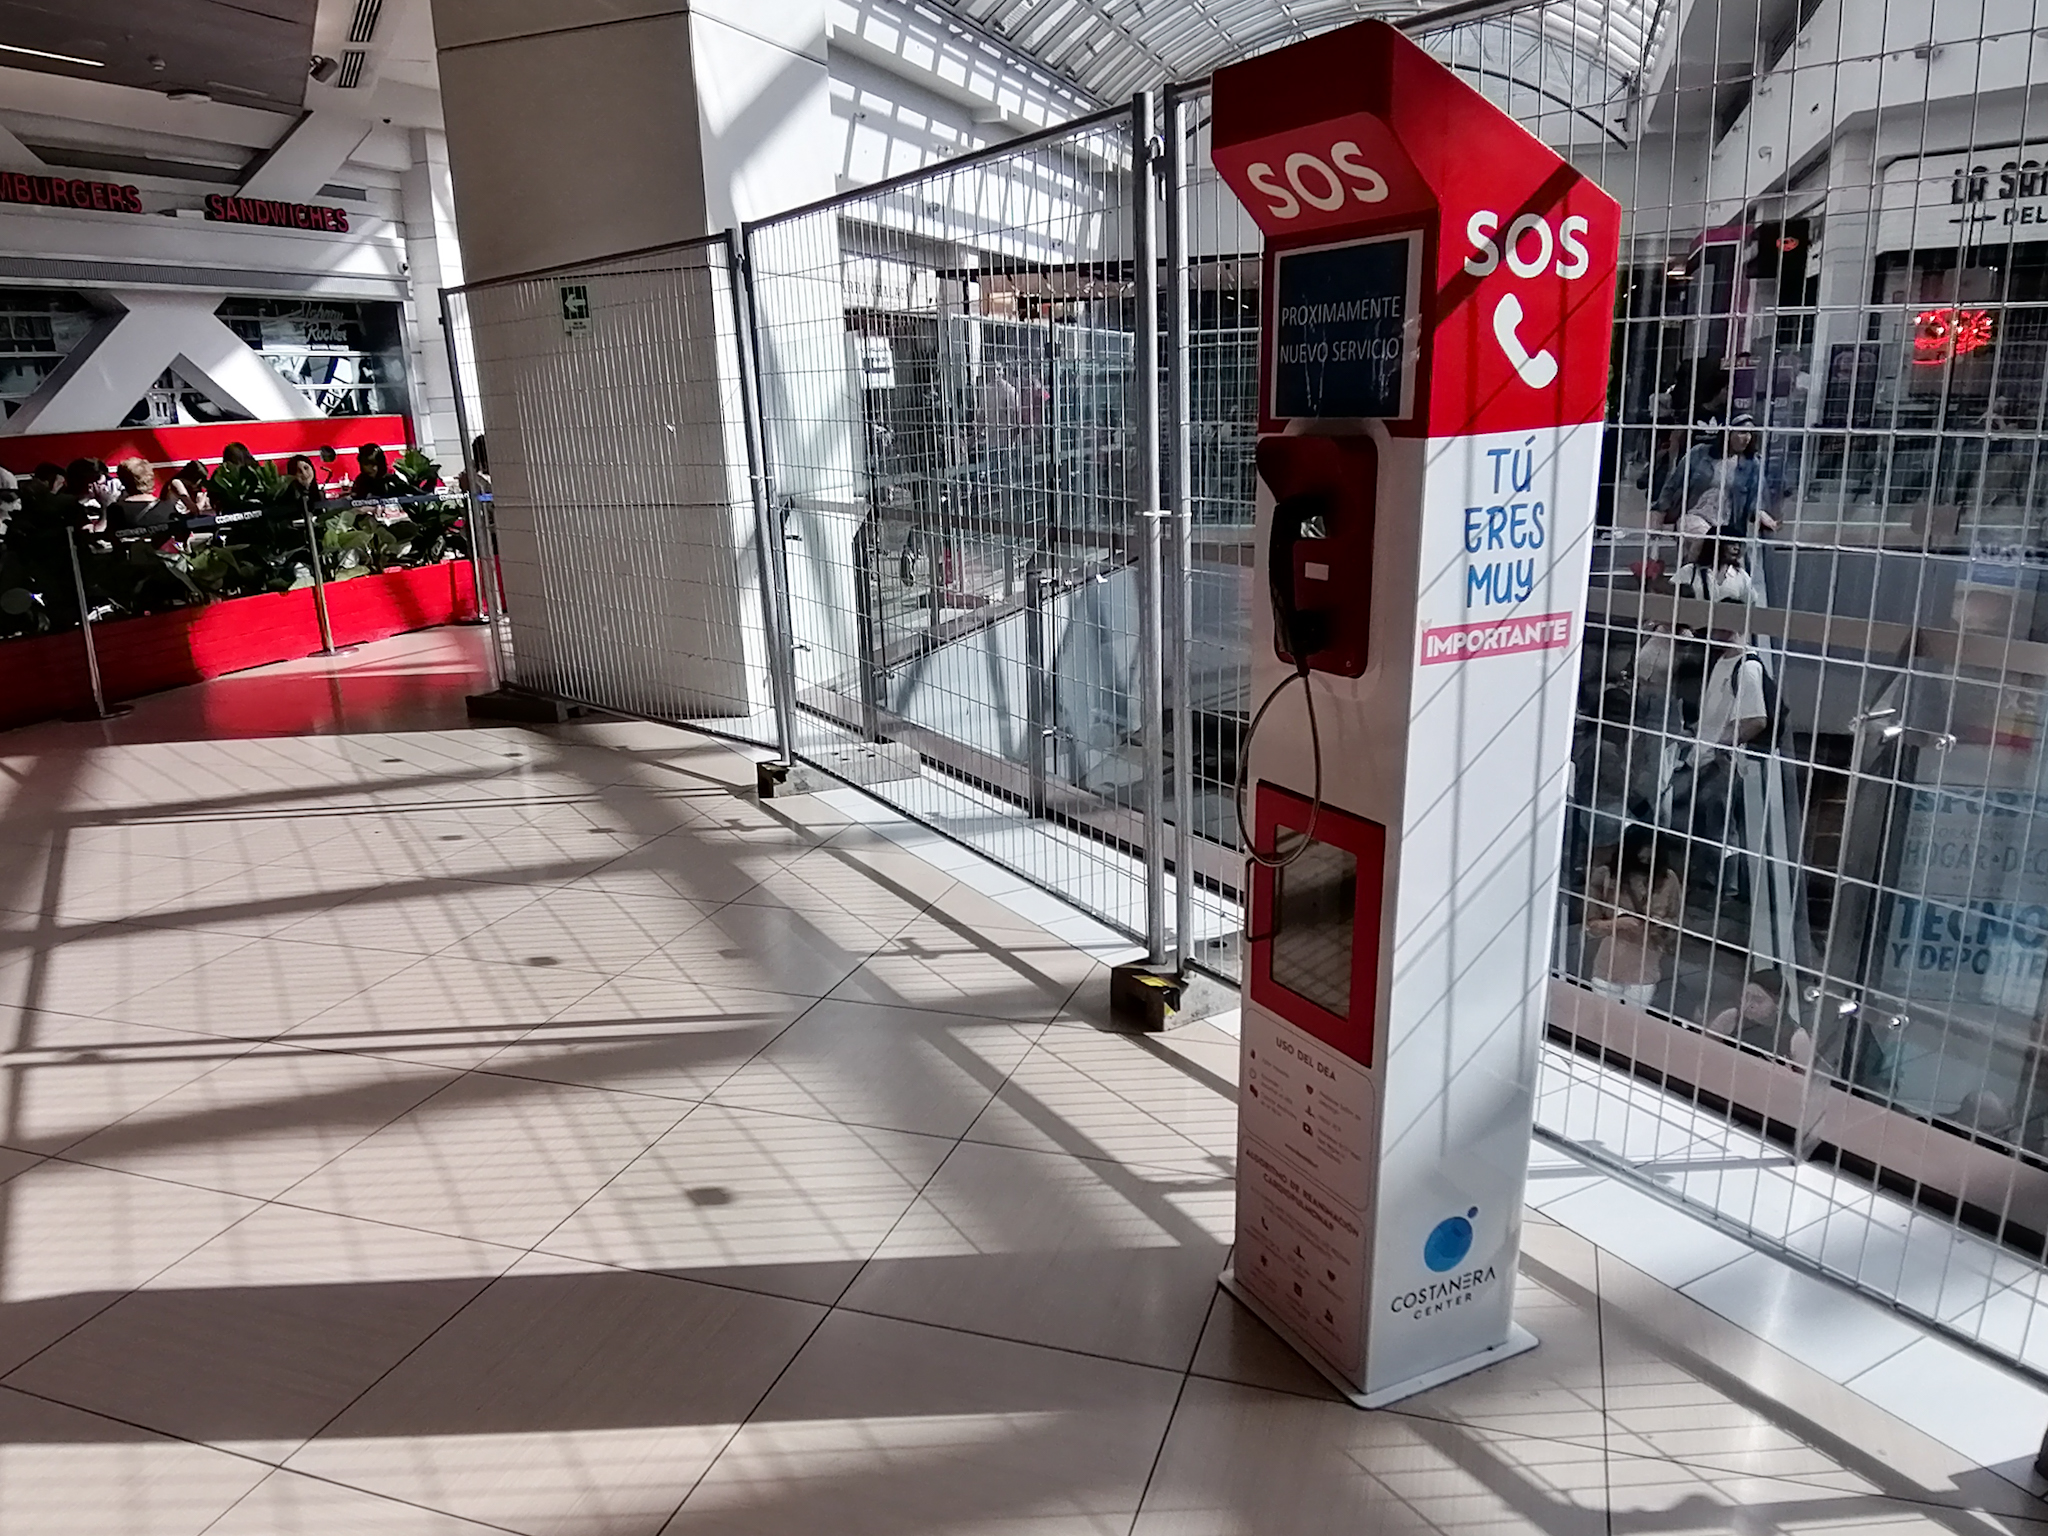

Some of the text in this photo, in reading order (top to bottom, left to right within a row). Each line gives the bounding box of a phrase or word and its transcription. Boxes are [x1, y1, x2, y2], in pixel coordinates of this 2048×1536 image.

[1247, 140, 1389, 220] SOS
[1951, 165, 1989, 204] LA
[210, 196, 349, 233] SANDWICHES
[1464, 209, 1590, 280] SOS
[1281, 296, 1401, 327] PROXIMAMENTE
[1280, 337, 1400, 364] NUEVO SERVICIO
[1487, 434, 1536, 494] TÚ
[1464, 501, 1545, 554] ERES
[1466, 557, 1535, 608] MUY
[1426, 617, 1569, 658] IMPORTANTE
[1899, 896, 2048, 948] TECNO
[1892, 943, 1910, 969] Y
[1275, 1036, 1294, 1055] USO
[1297, 1049, 1314, 1068] DEL
[1316, 1061, 1337, 1082] DEA
[1391, 1266, 1496, 1313] COSTANERA
[1413, 1293, 1472, 1320] CENTER
